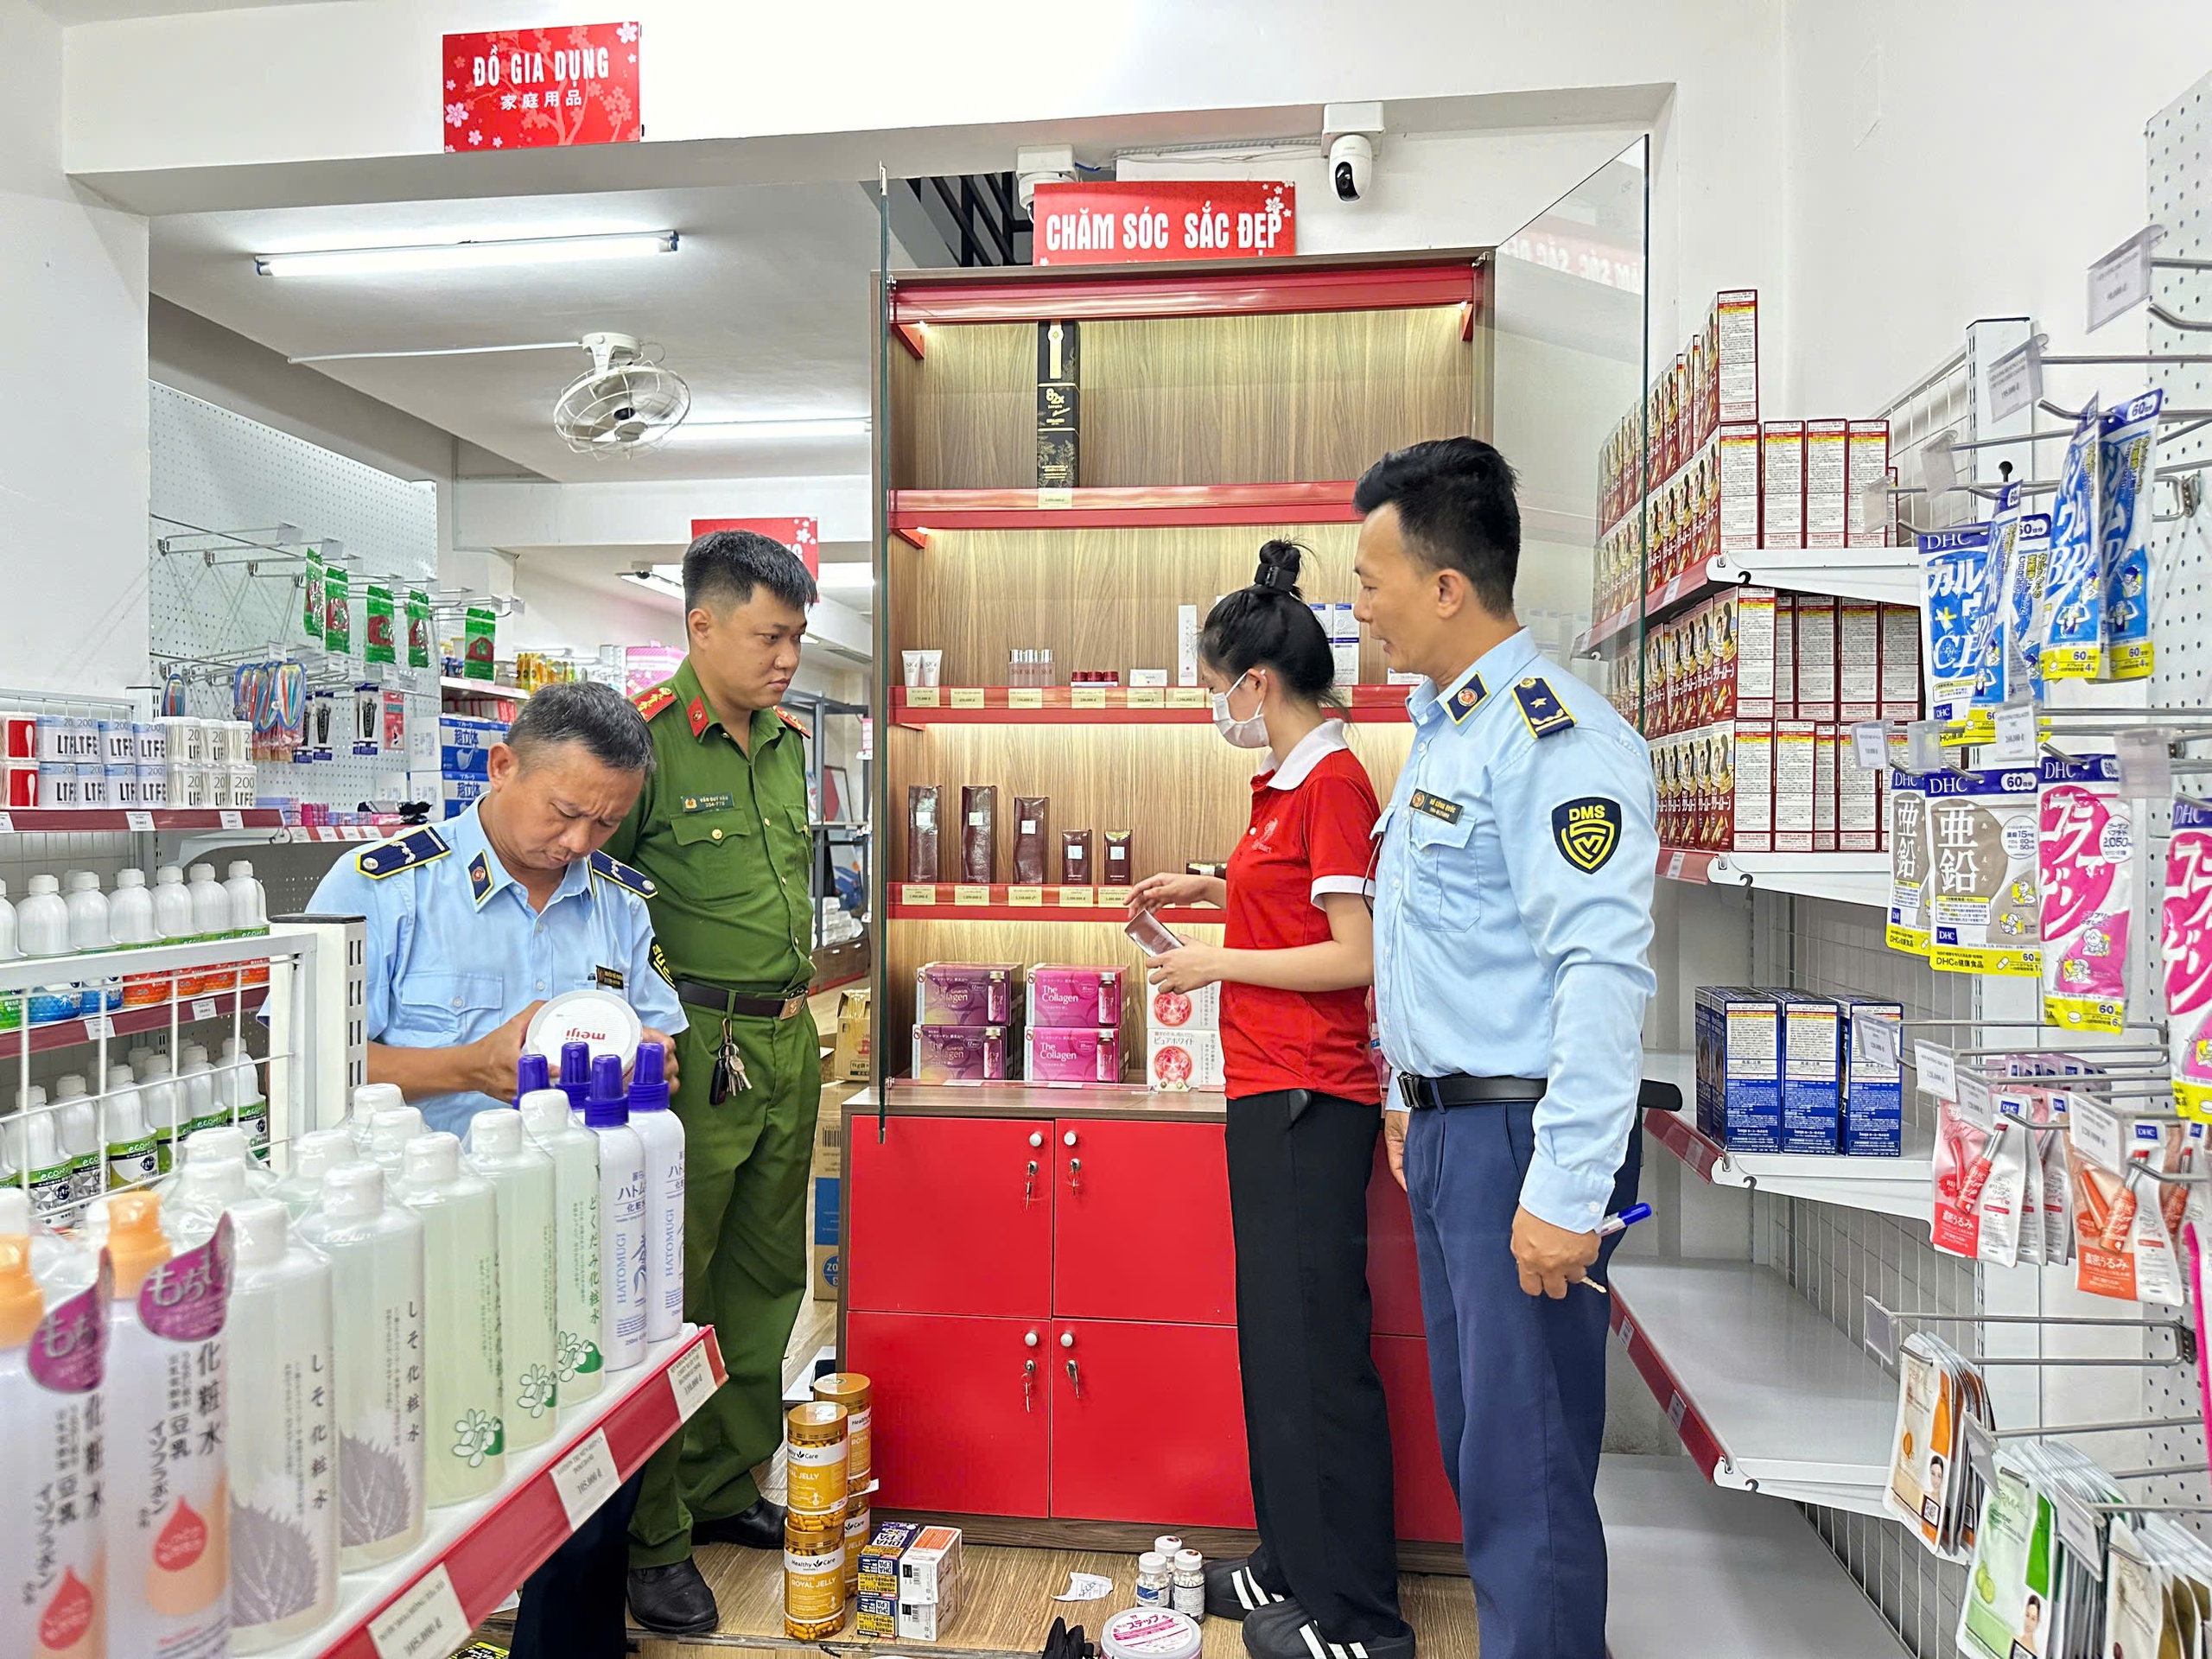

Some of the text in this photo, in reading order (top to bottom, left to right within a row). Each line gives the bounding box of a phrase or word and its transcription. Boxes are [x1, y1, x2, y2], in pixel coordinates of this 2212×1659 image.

[473, 46, 609, 87] ĐỒ GIA DỤNG
[500, 90, 582, 111] 家庭用品
[1046, 201, 1282, 256] CHĂM SÓC SẮC ĐẸP
[1926, 534, 1971, 550] DHC
[188, 729, 200, 741] 20
[213, 731, 224, 743] 20
[454, 729, 479, 747] 超立体
[57, 734, 73, 754] LIF
[189, 745, 200, 760] LIF
[213, 747, 224, 760] LIF
[2044, 761, 2075, 779] DHC
[188, 775, 200, 787] 20
[214, 777, 225, 788] 20
[234, 777, 254, 789] 200
[1894, 773, 1916, 787] DHC
[1929, 778, 1967, 793] DHC
[189, 791, 200, 806] LIF
[1568, 804, 1605, 821] DMS
[1897, 798, 1920, 879] 亜鉛
[1937, 804, 1979, 893] 亜鉛
[1939, 931, 1955, 941] DHC
[1042, 985, 1058, 994] The
[1042, 993, 1078, 1004] Collagen
[565, 1027, 606, 1041] meiji
[1154, 1037, 1193, 1046] ピュアホワイト
[1040, 1050, 1077, 1061] Collagen
[2138, 1128, 2156, 1137] DHC
[664, 1209, 675, 1277] HATOMUGI
[617, 1233, 626, 1304] HATOMUGI
[406, 1300, 420, 1443] しそ化粧水
[197, 1341, 222, 1456] 化粧水
[310, 1354, 328, 1510] しそ化粧水
[798, 1472, 819, 1481] JELLY
[823, 1557, 836, 1566] Care
[816, 1577, 836, 1587] JELLY
[1127, 1614, 1159, 1630] ステップ
